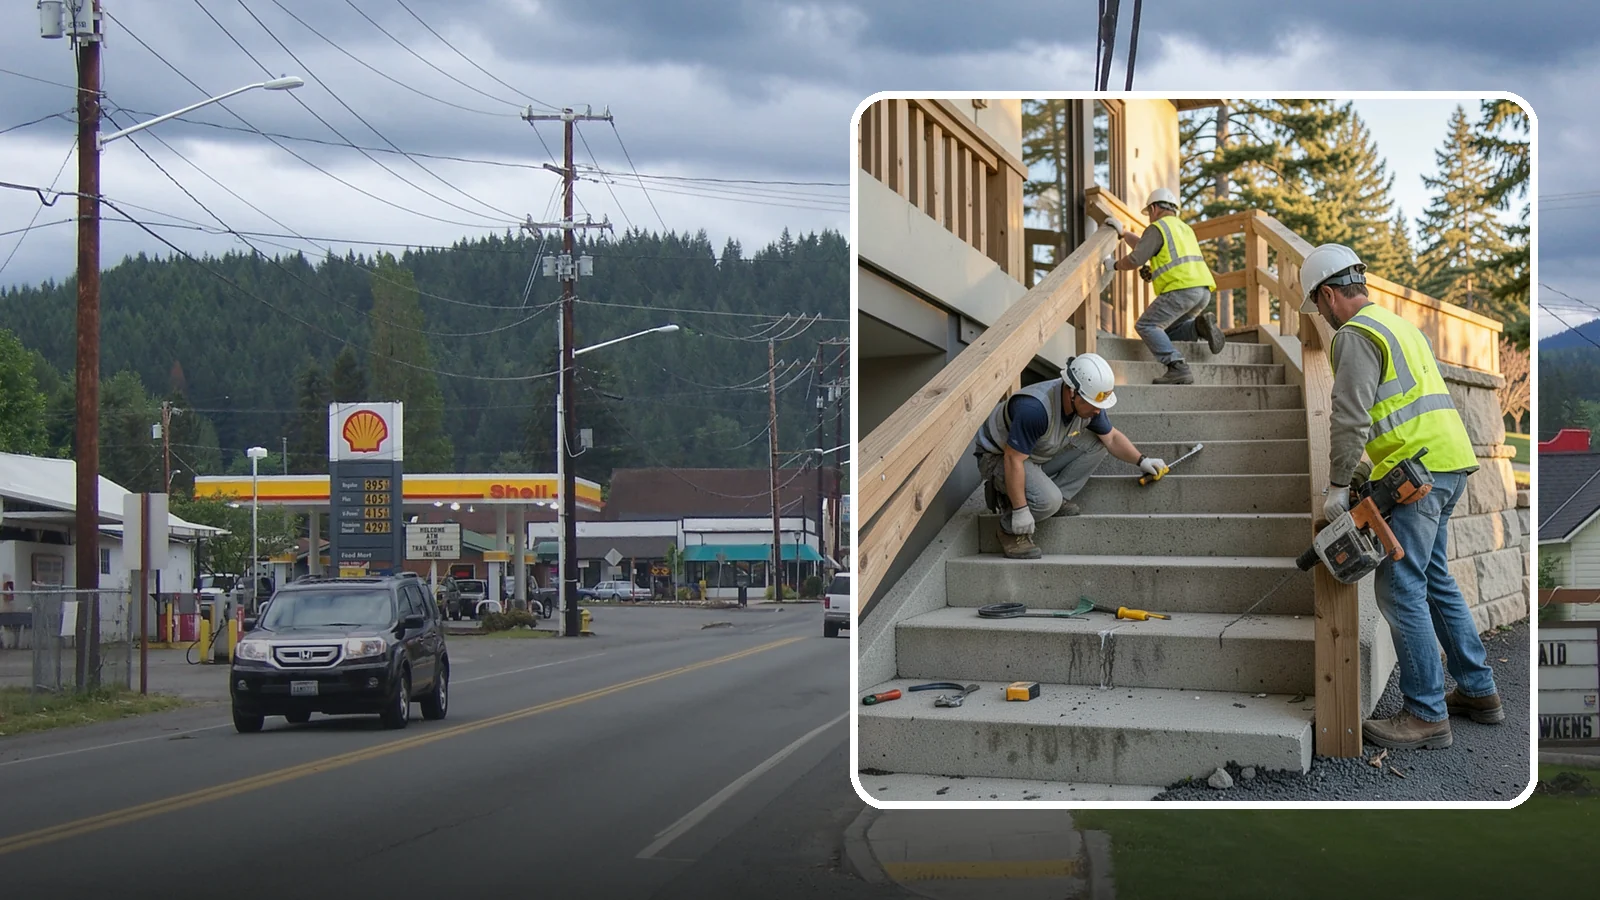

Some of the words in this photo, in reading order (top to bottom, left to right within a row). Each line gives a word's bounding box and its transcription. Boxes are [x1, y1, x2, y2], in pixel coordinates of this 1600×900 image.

[490, 484, 547, 499] Shell
[366, 508, 383, 518] 415
[366, 522, 383, 532] 429
